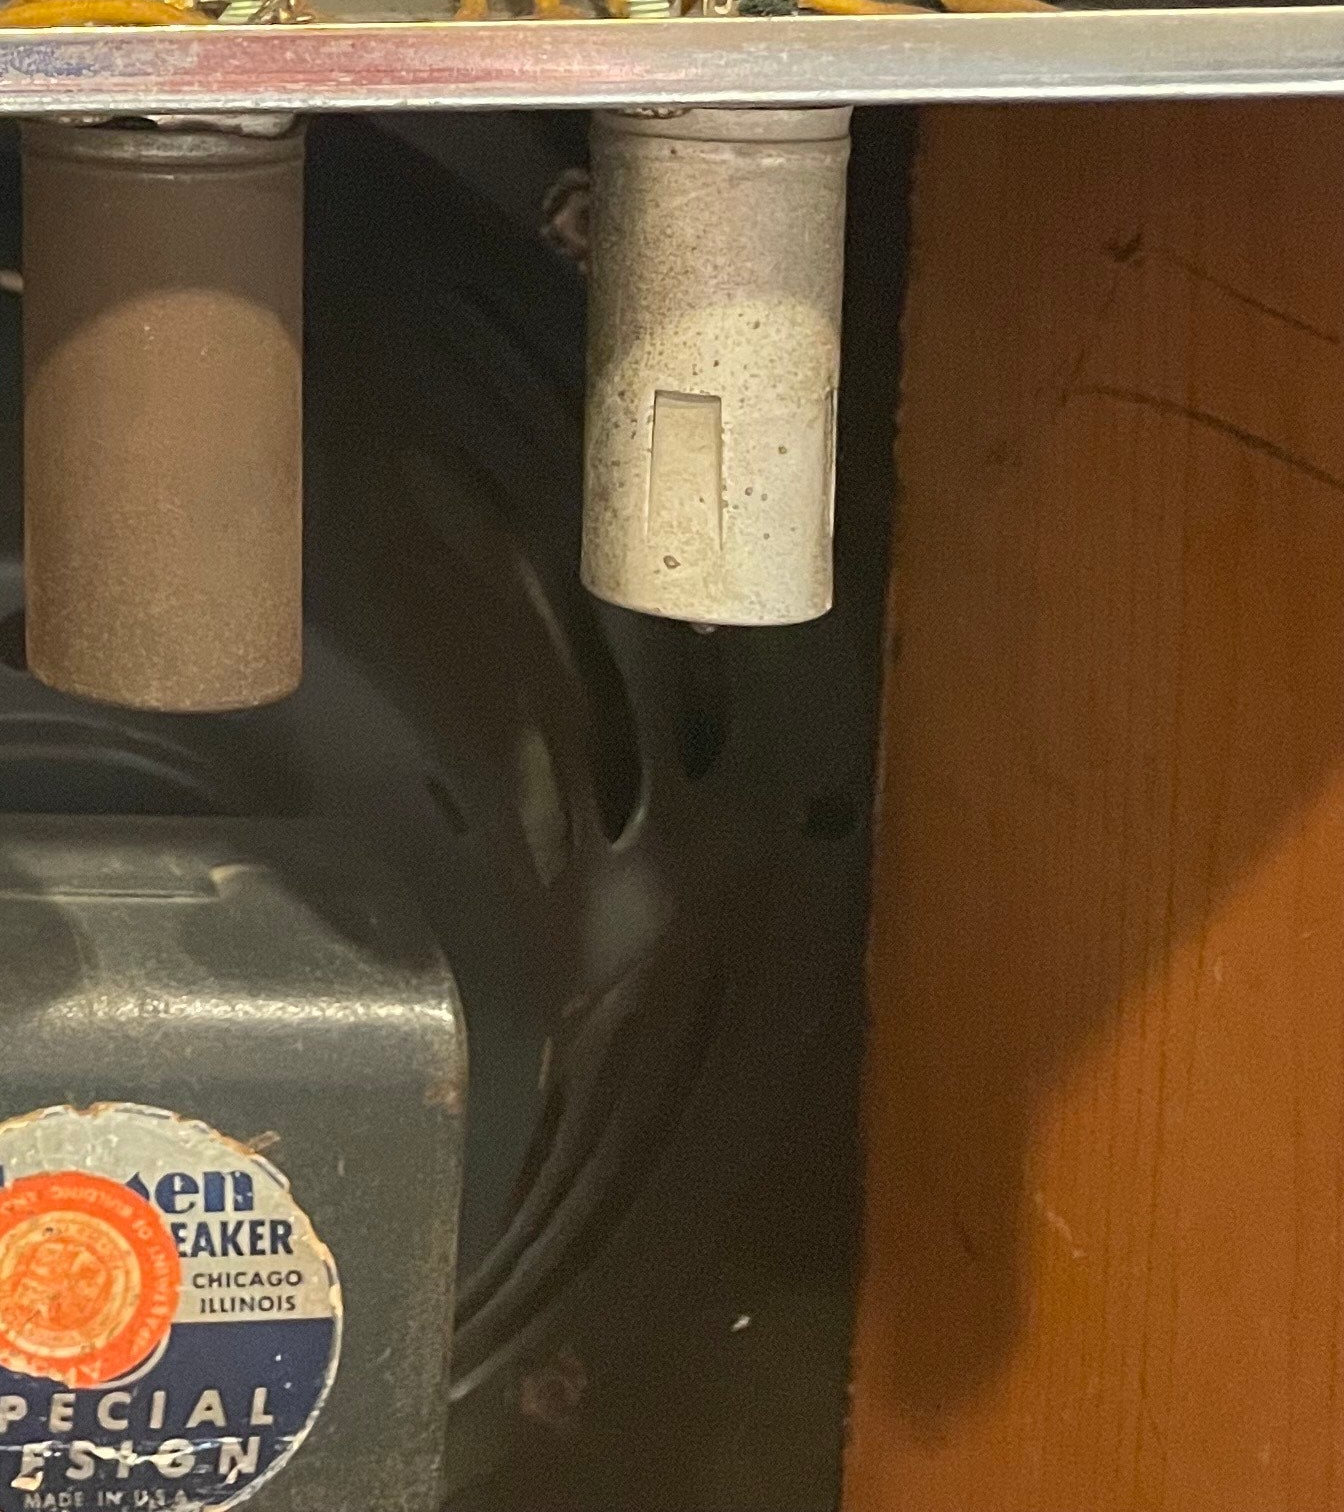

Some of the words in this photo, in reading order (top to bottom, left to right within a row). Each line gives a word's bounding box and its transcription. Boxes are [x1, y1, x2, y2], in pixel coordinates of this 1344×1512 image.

[192, 1269, 303, 1289] CHICAGO
[200, 1294, 297, 1315] ILLINOIS
[23, 1490, 84, 1511] MADE
[96, 1489, 122, 1508] IN
